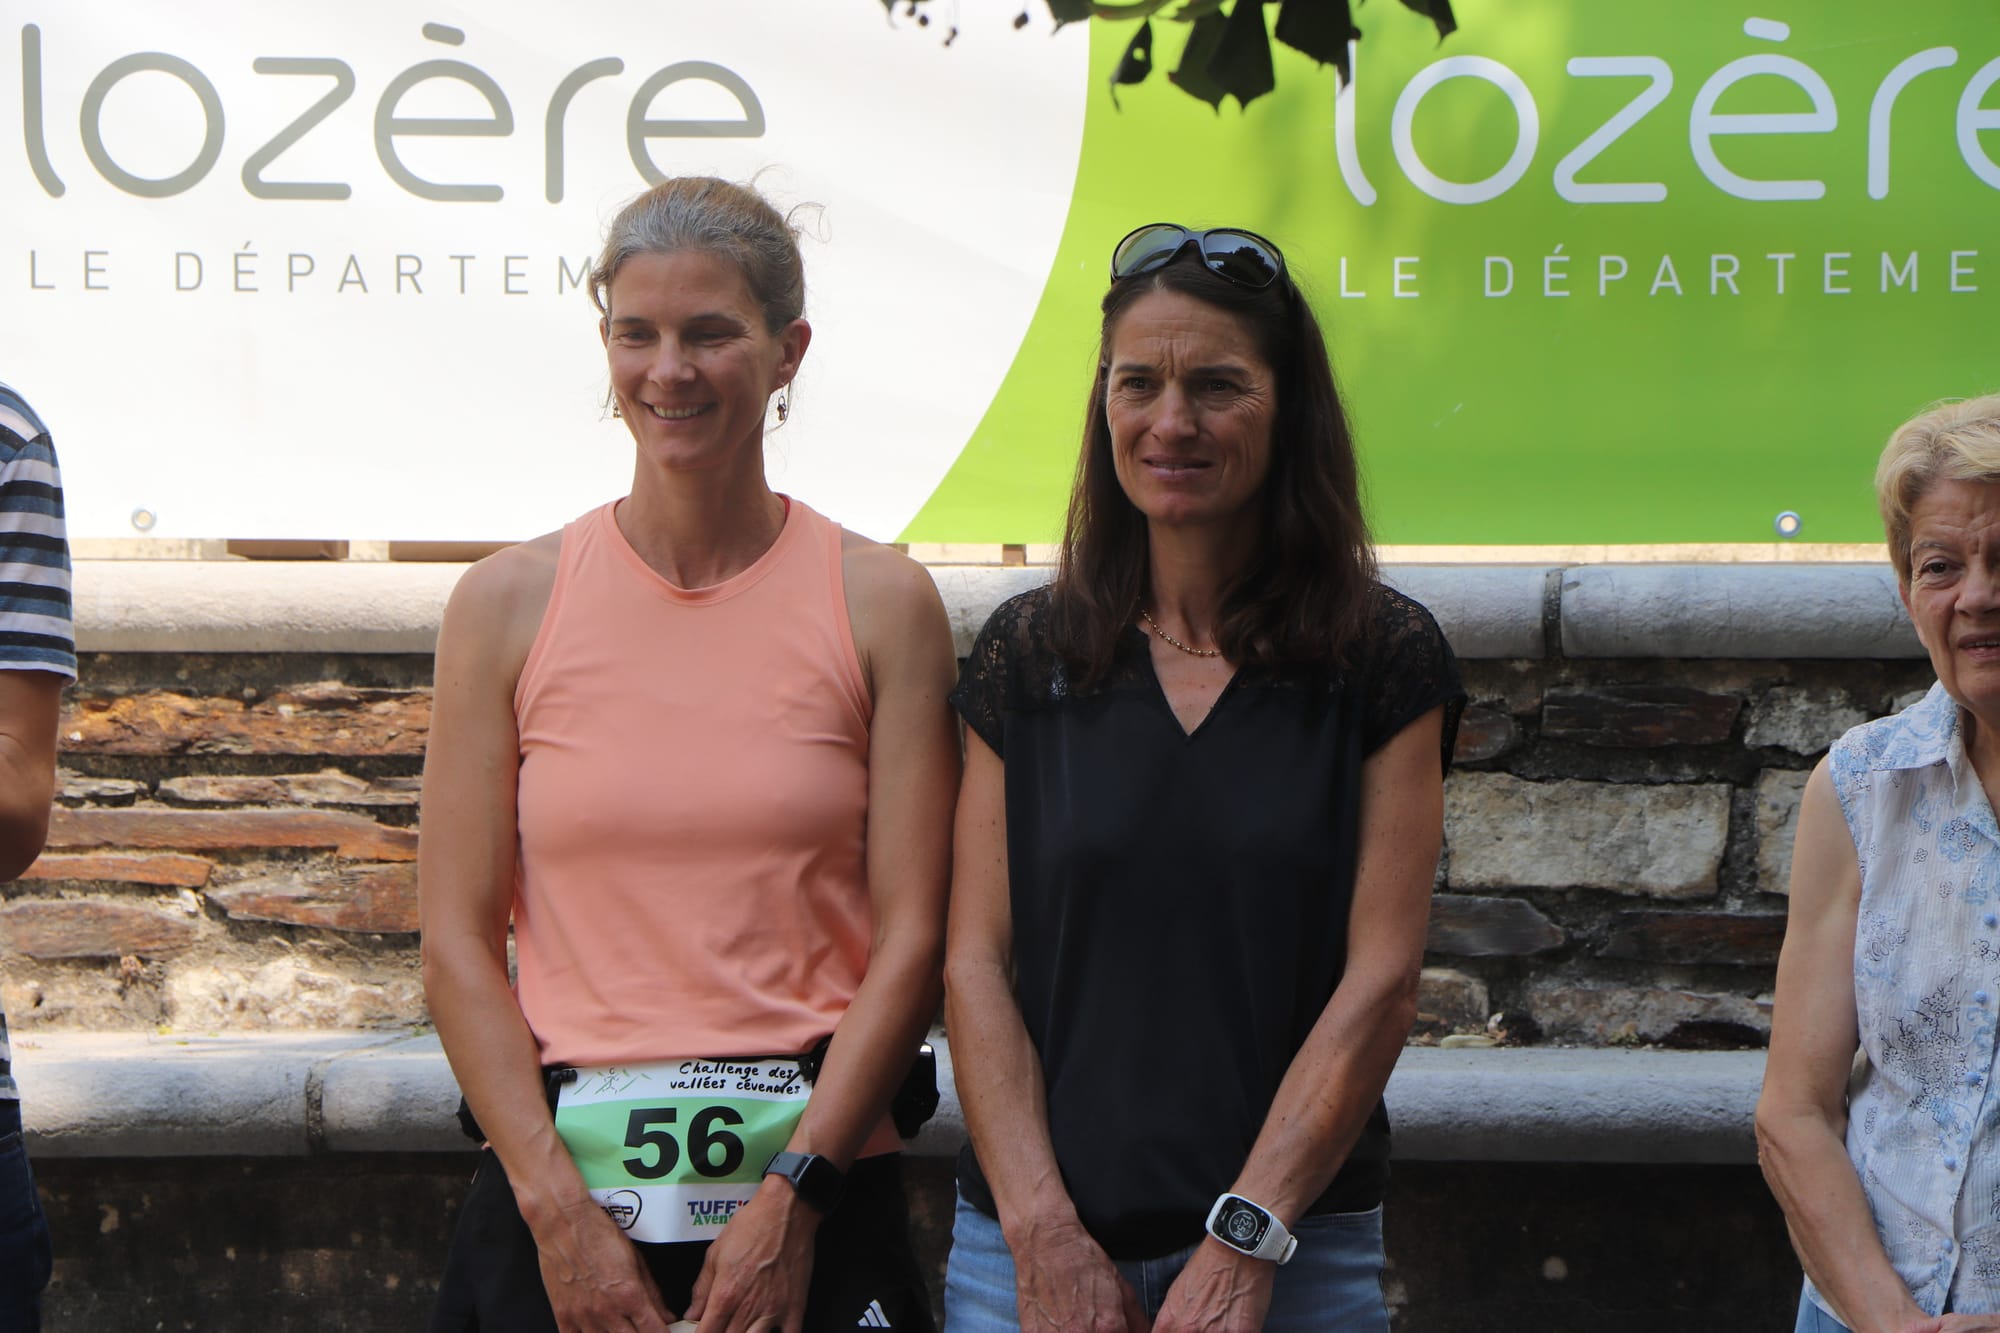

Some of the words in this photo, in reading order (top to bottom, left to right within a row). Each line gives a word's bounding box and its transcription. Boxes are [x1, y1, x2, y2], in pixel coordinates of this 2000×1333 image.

[22, 22, 766, 204] lozère
[30, 250, 110, 290] LE
[1340, 257, 1420, 298] LE
[1484, 245, 1978, 297] DÉPARTEME
[670, 1076, 726, 1089] vallées
[679, 1061, 759, 1079] Challenge
[768, 1066, 793, 1079] des
[623, 1106, 745, 1180] 56
[687, 1200, 751, 1215] TUFF'
[692, 1211, 735, 1225] Aven
